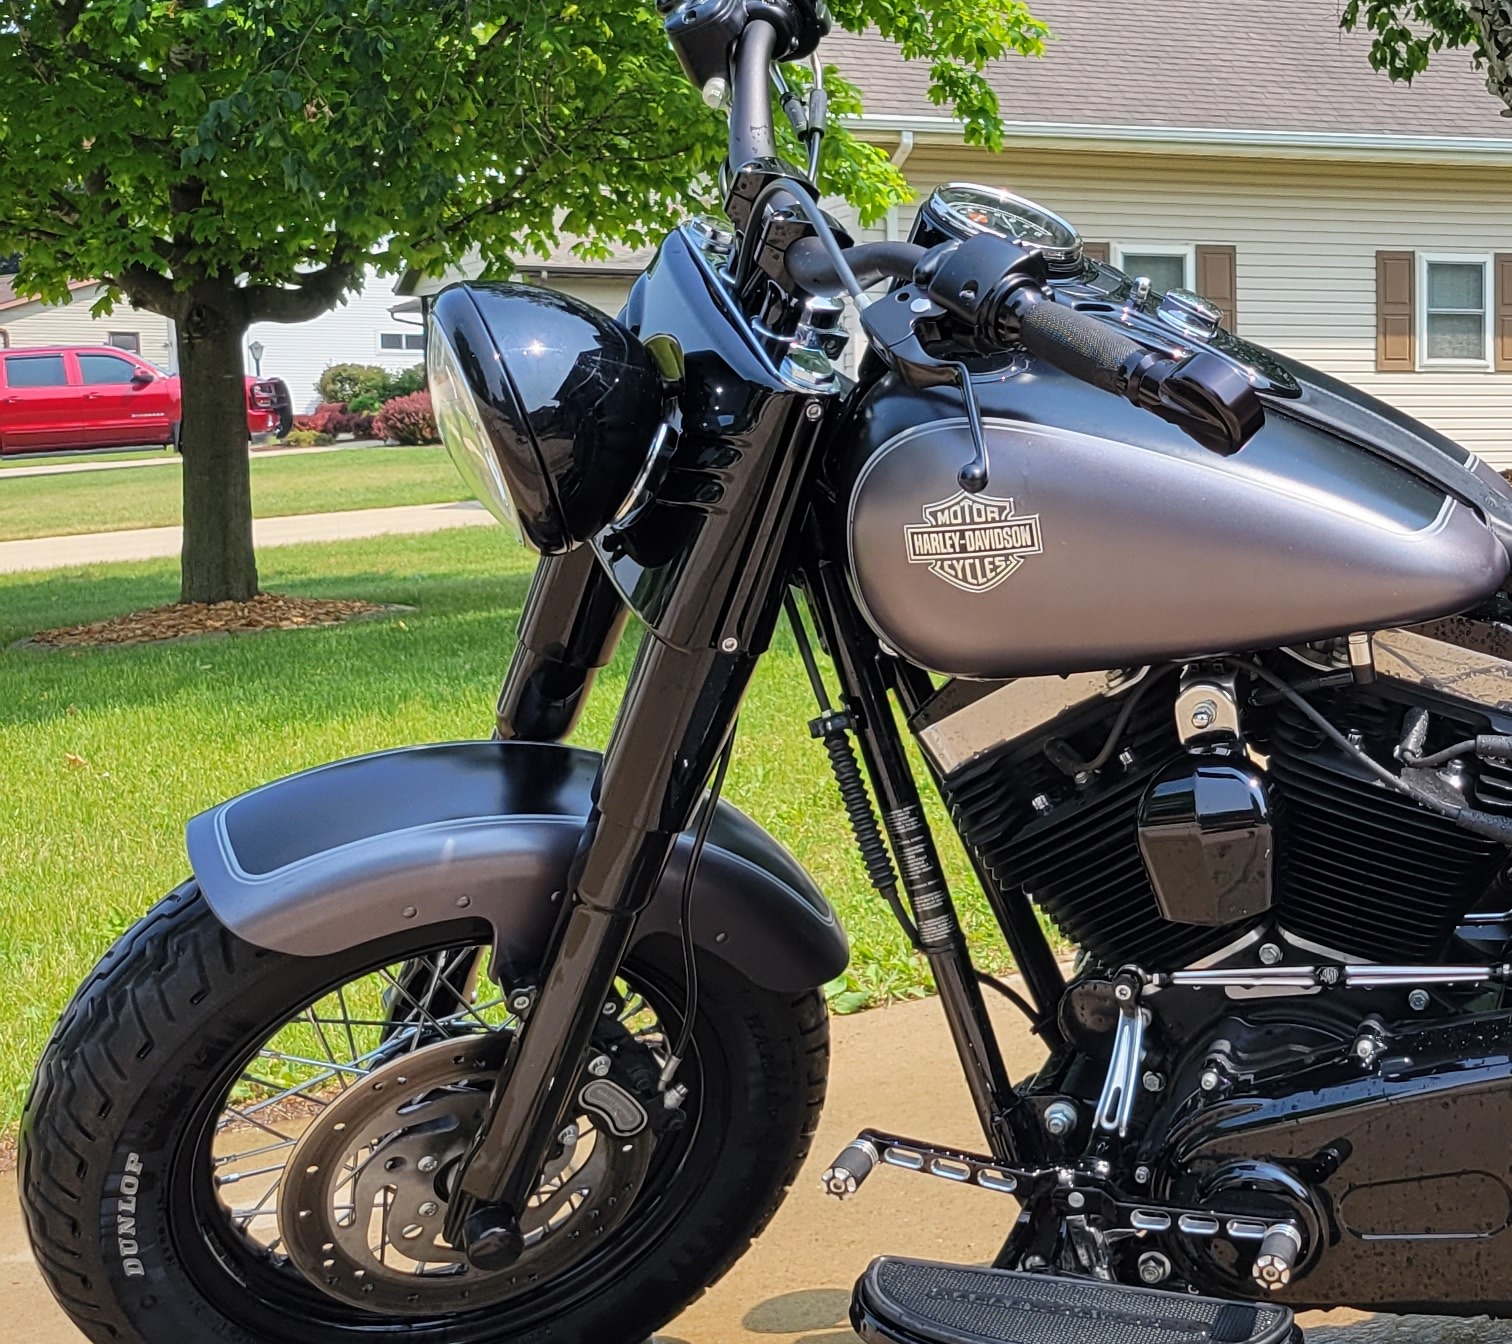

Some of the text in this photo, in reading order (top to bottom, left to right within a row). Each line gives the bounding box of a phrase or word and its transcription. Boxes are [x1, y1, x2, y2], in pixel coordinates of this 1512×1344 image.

[937, 499, 999, 524] MOTOR
[914, 525, 1031, 554] HARLEY-DAVIDSON
[117, 1152, 145, 1276] DUNLOP
